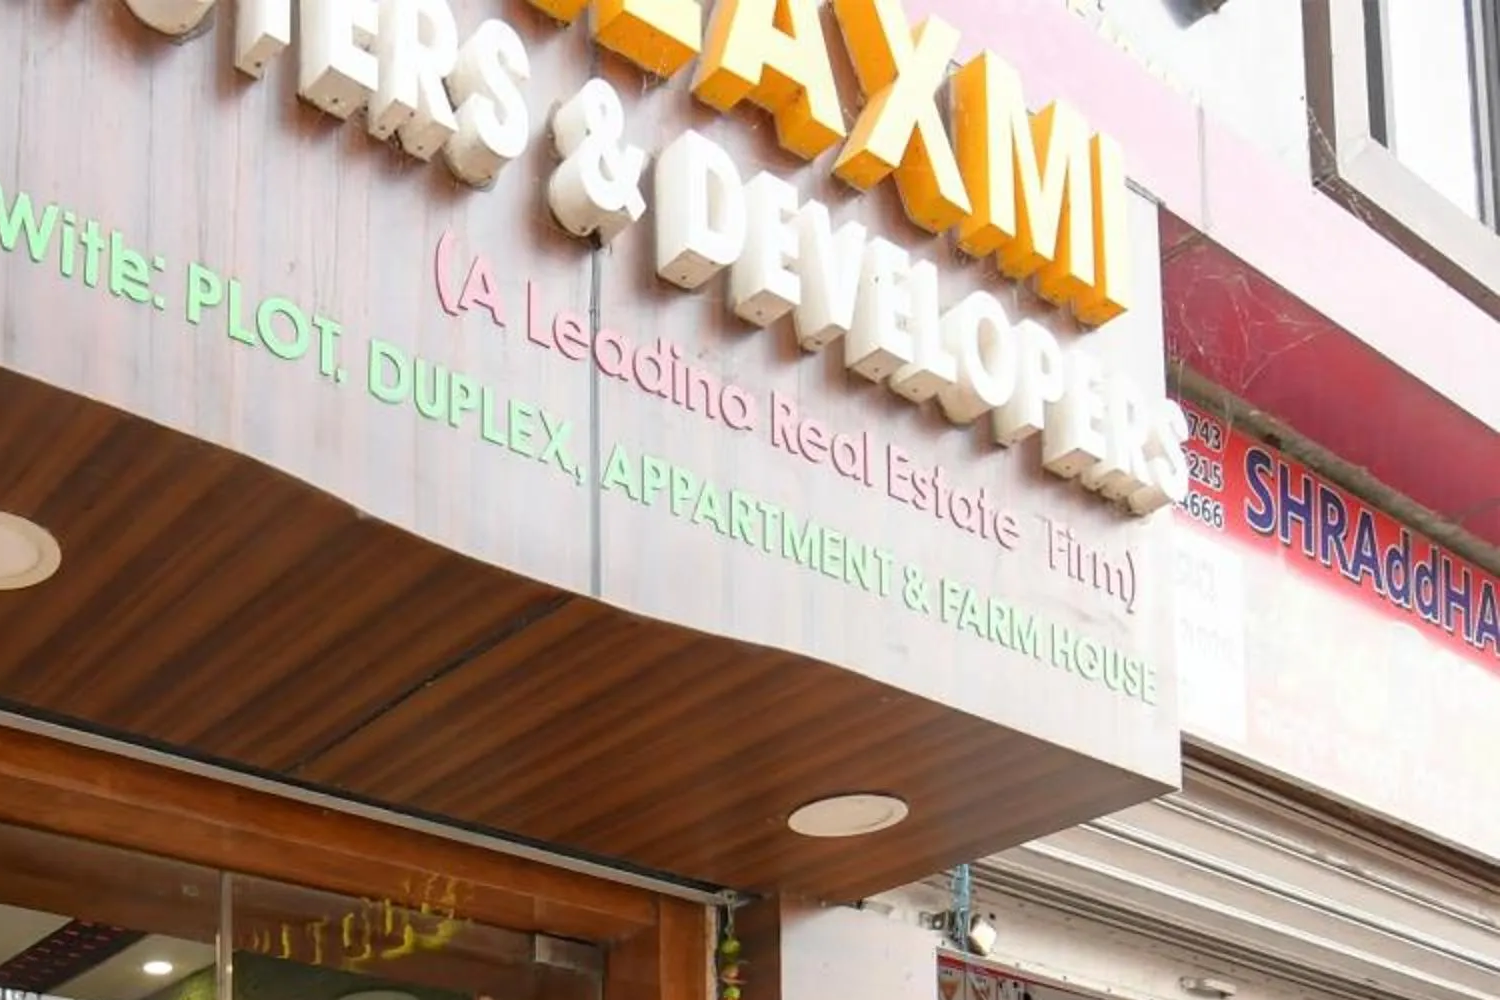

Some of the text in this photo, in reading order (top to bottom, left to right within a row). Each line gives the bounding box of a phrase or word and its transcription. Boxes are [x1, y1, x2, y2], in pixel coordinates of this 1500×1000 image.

[434, 224, 506, 328] (A
[769, 389, 874, 488] Real
[886, 443, 1021, 551] Estate
[549, 77, 647, 246] &
[653, 128, 1190, 516] DEVELOPERS
[1180, 447, 1224, 492] 215
[1182, 406, 1223, 452] 743
[600, 442, 895, 597] APPARTMENT
[902, 565, 930, 616] &
[939, 577, 1042, 660] FARM
[1050, 623, 1158, 706] HOUSE
